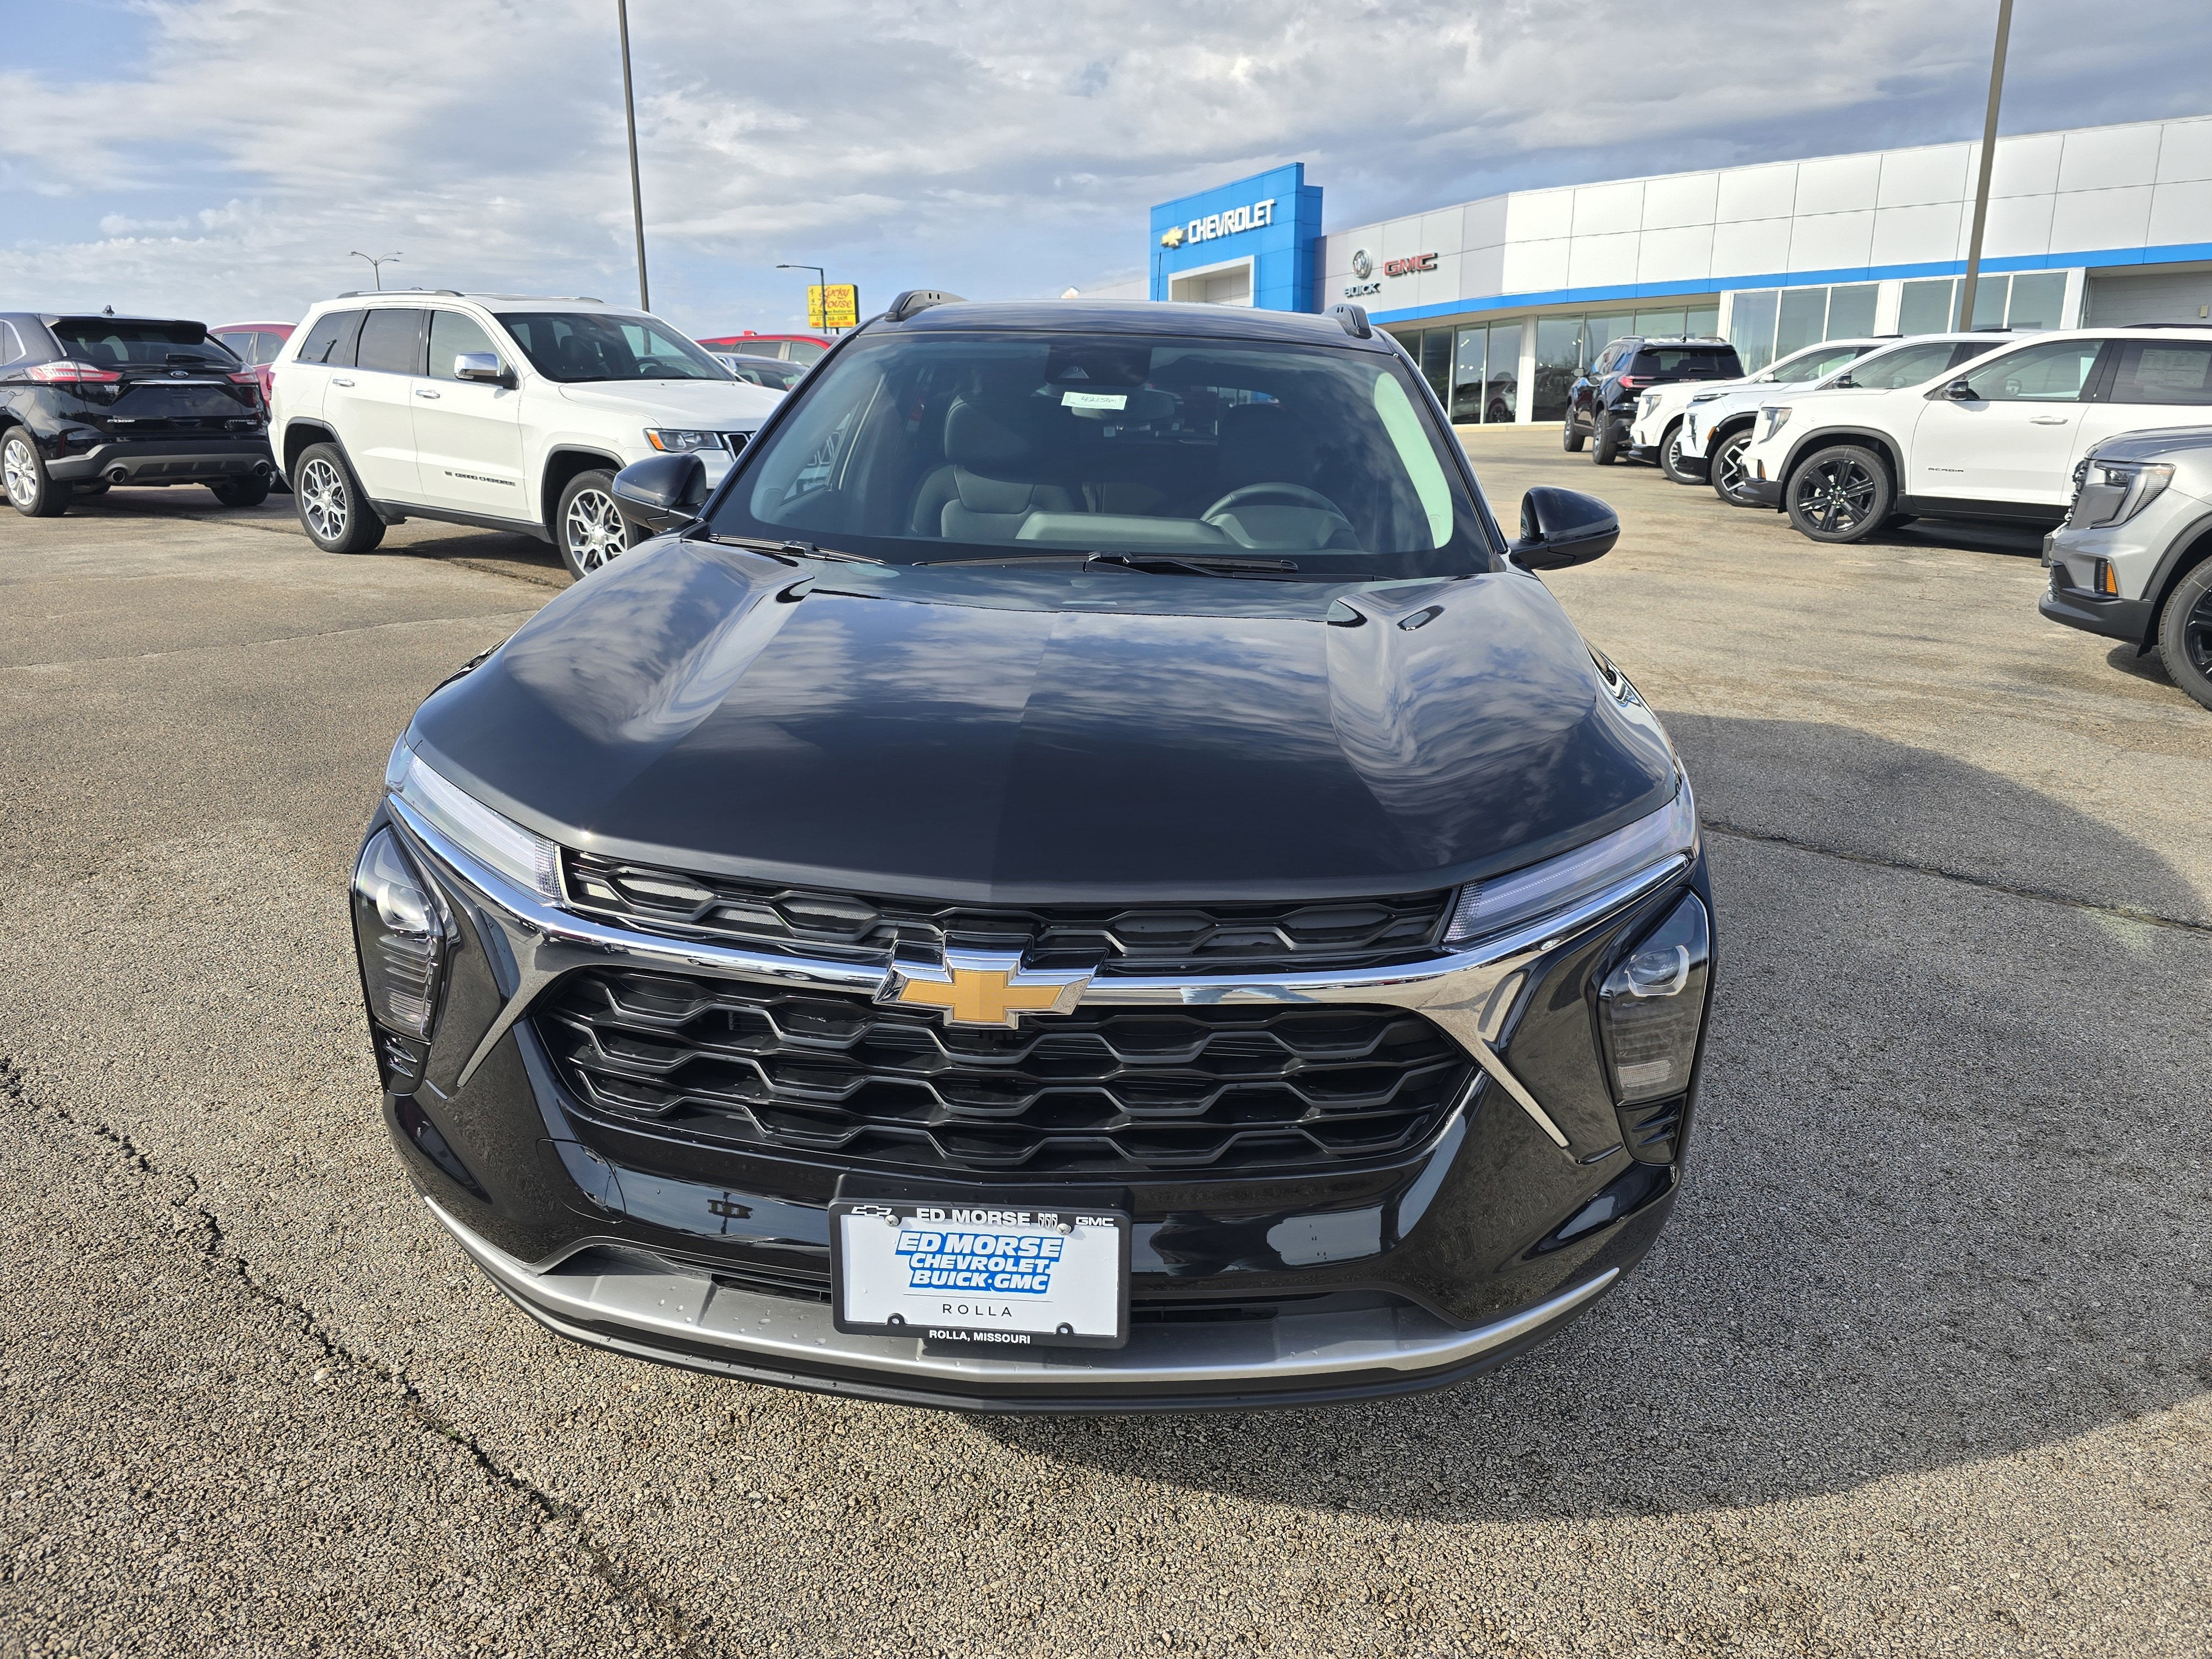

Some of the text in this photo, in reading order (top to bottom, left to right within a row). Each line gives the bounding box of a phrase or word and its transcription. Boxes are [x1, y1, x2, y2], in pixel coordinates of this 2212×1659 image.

[1188, 199, 1275, 244] CHEVROLET
[1384, 253, 1438, 277] GMC
[1345, 283, 1380, 298] BUICK
[916, 1208, 1031, 1227] ED MORSE
[1076, 1216, 1114, 1227] GMC
[897, 1232, 1063, 1258] ED MORSE
[910, 1253, 1050, 1273] CHEVROLET
[942, 1303, 1013, 1317] ROLLA
[929, 1329, 1031, 1344] ROLLA, MISSOURI
